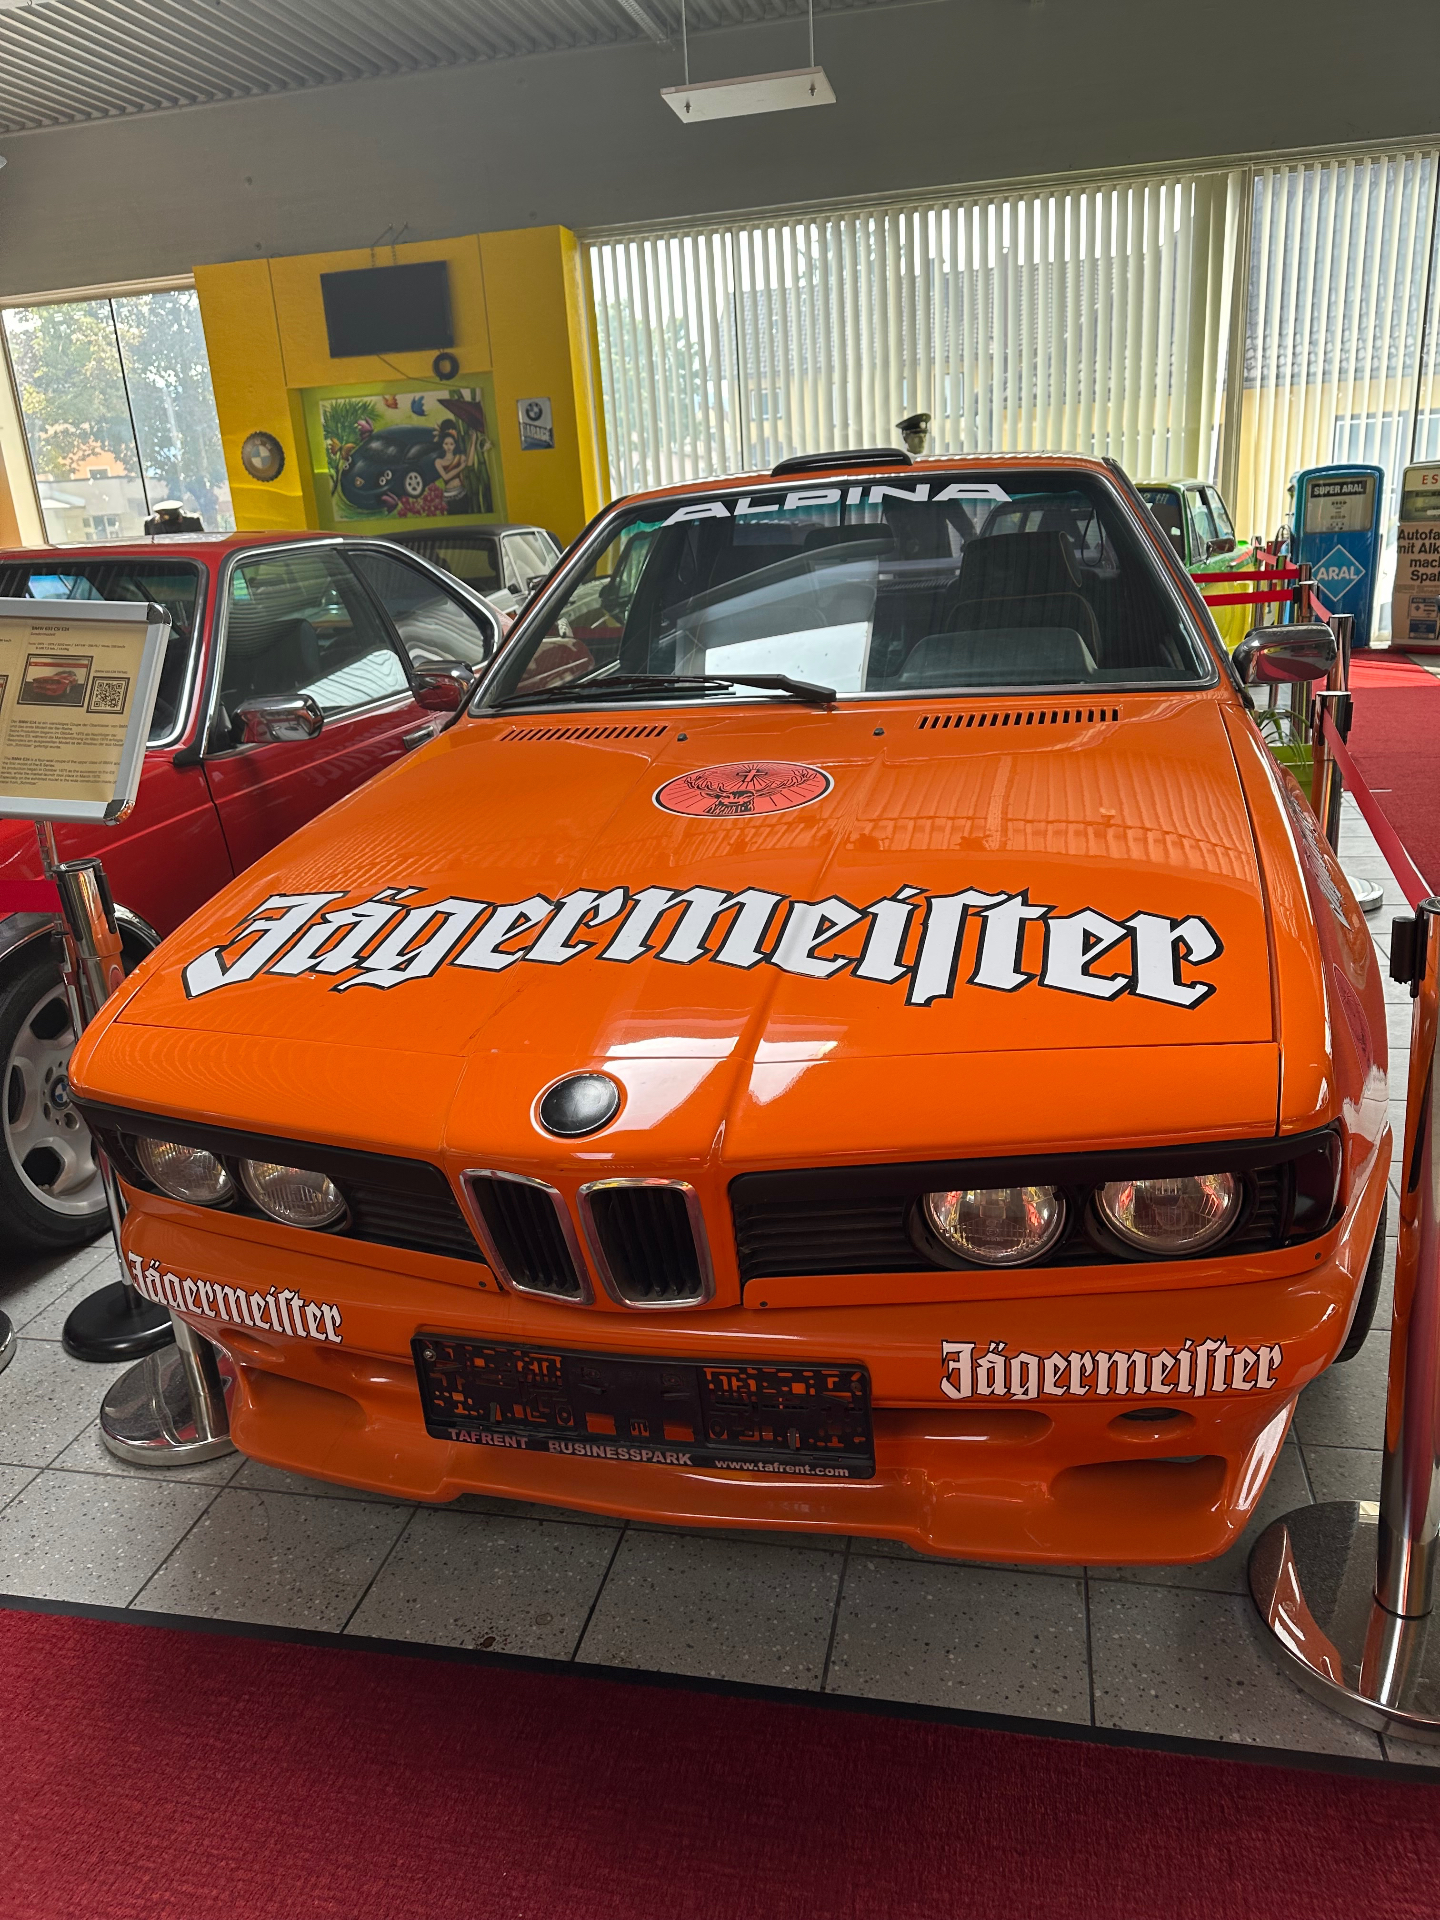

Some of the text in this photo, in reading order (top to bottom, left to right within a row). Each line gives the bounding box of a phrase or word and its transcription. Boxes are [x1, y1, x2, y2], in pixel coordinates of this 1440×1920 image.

[660, 483, 1013, 527] ALPINA
[1313, 483, 1364, 496] SUPER ARAL
[1316, 566, 1358, 581] ARAL
[181, 882, 1225, 1011] Jägermeister
[939, 1335, 1283, 1401] Jägermeister
[448, 1428, 850, 1478] TAFRENT BUSINESSPARK www.tafrent.com
